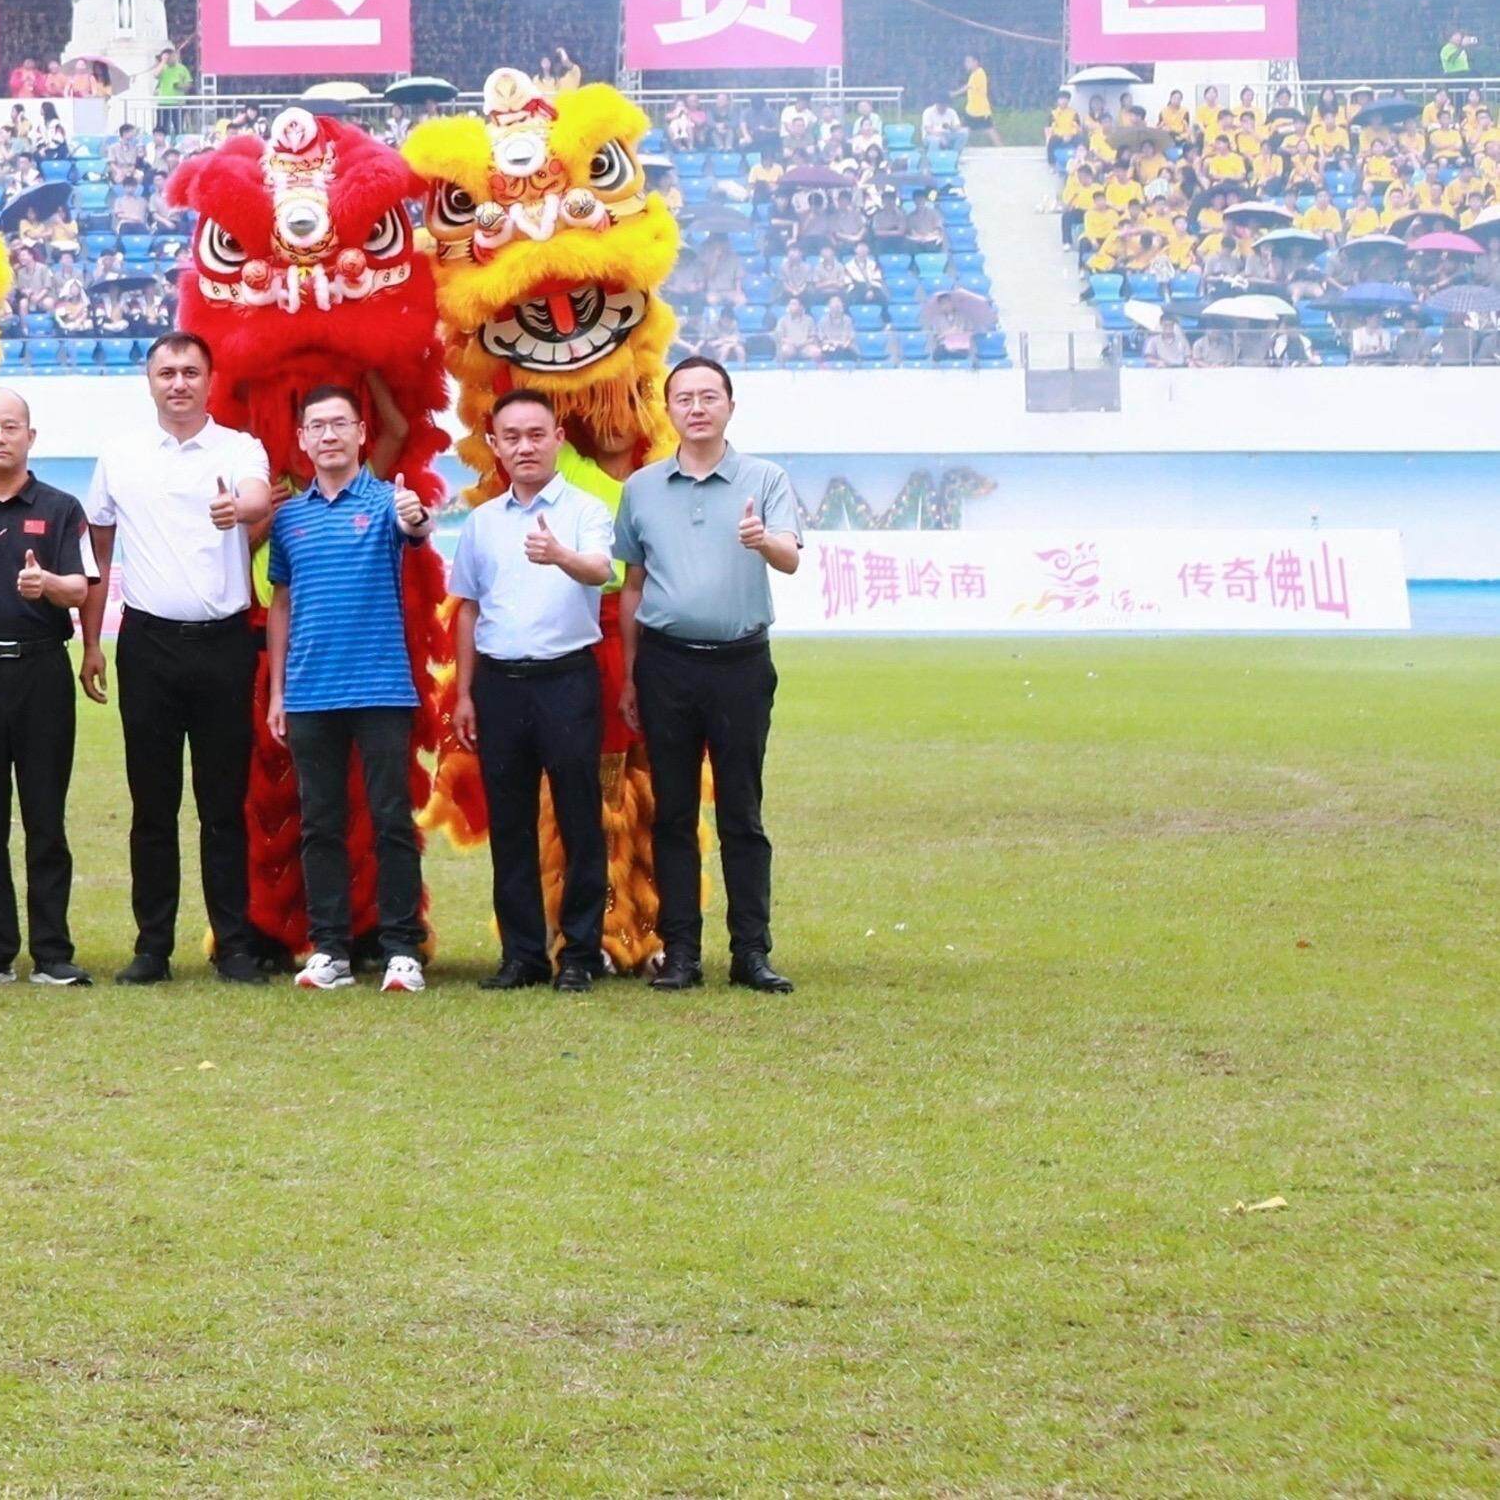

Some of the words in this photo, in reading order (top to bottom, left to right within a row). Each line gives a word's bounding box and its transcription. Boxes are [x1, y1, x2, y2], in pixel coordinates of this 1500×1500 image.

[818, 543, 986, 619] 狮舞岭南
[1177, 541, 1350, 619] 传奇佛山
